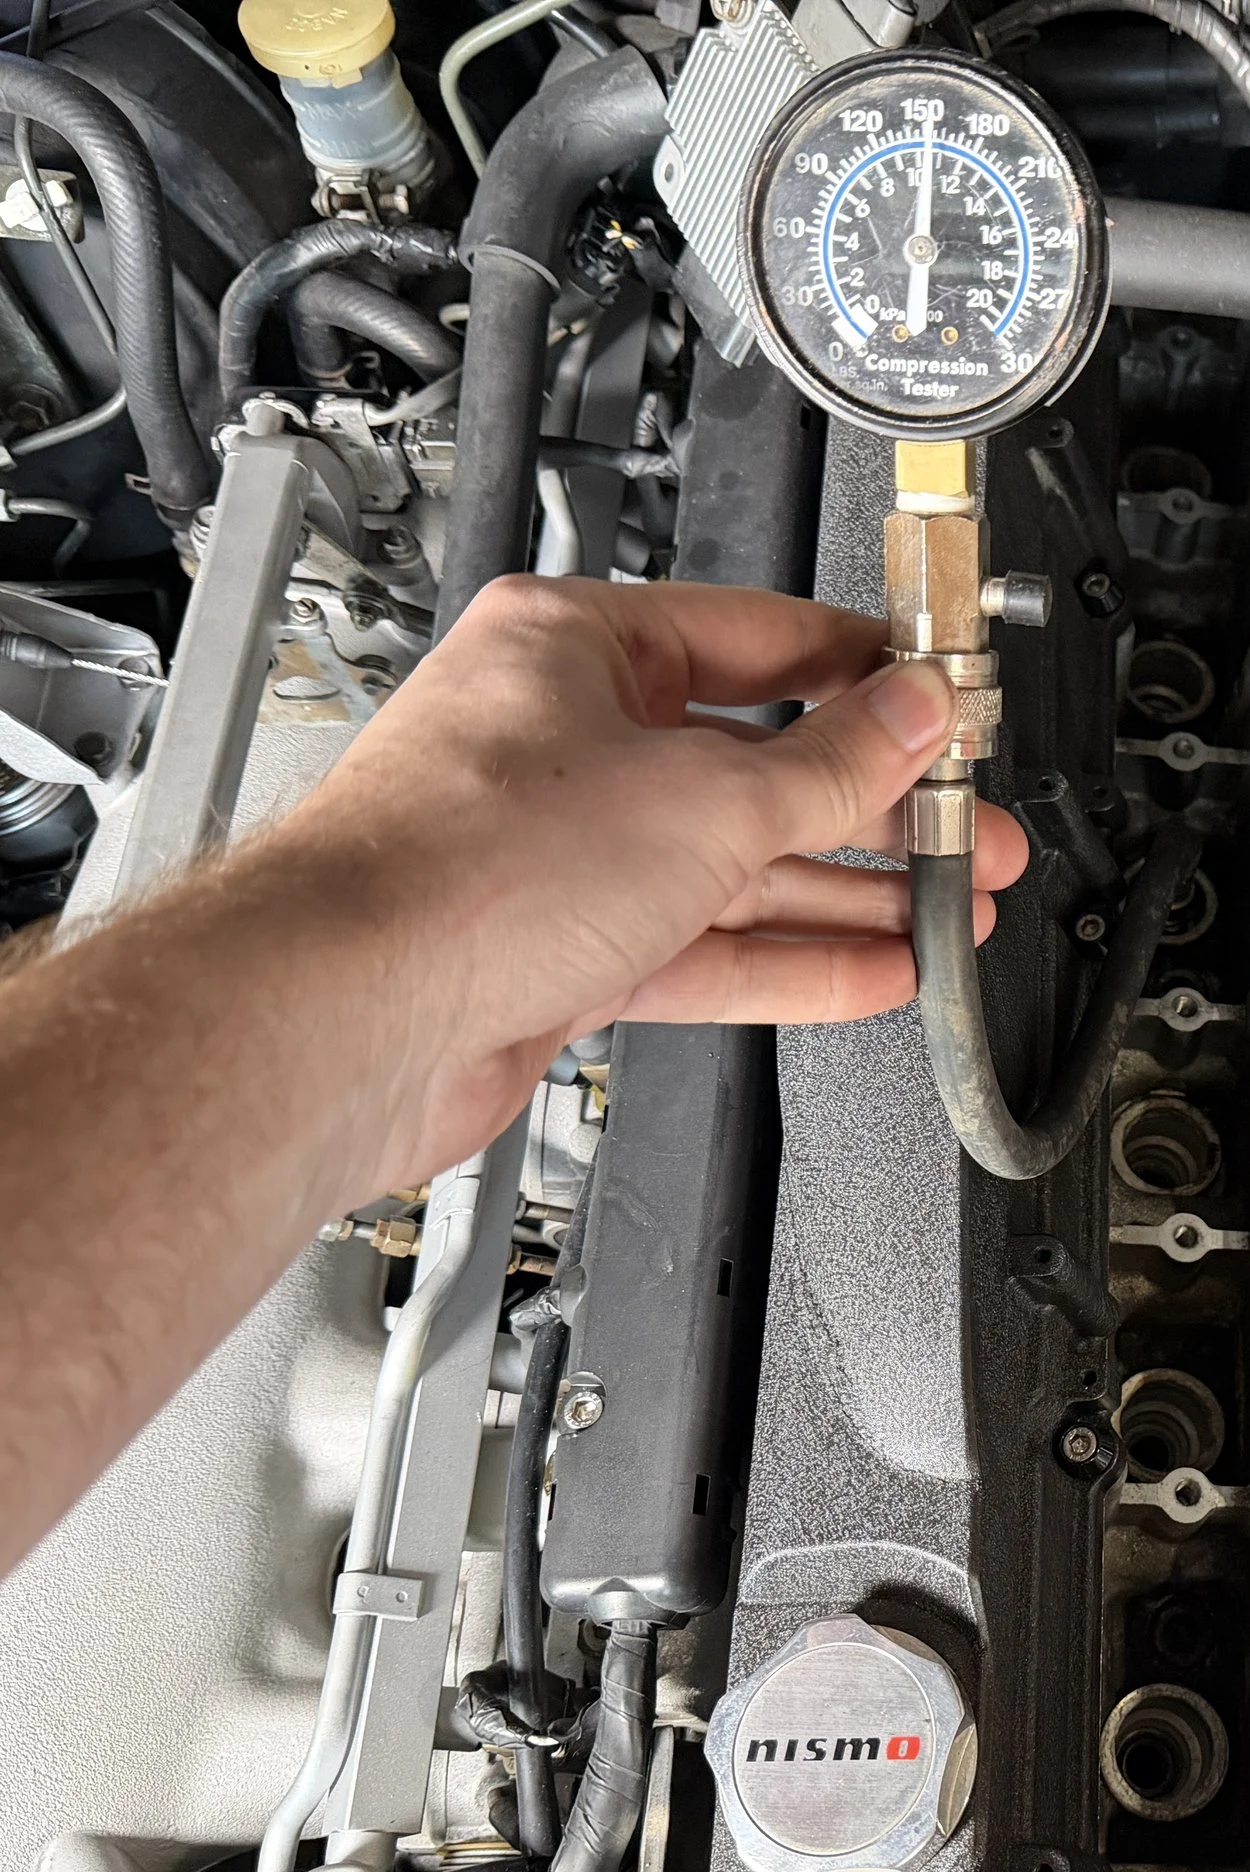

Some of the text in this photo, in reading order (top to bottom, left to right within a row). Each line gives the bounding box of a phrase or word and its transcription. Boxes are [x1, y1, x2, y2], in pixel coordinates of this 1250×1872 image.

[901, 98, 945, 121] 150
[839, 109, 883, 132] 120
[965, 113, 1010, 136] 180
[795, 152, 829, 175] 90
[1017, 156, 1062, 179] 210
[880, 178, 895, 197] 8
[939, 174, 961, 194] 12
[855, 199, 871, 218] 6
[963, 196, 986, 216] 14
[773, 217, 806, 239] 60
[980, 225, 1002, 244] 16
[1044, 227, 1079, 248] 24
[844, 232, 860, 251] 4
[850, 267, 865, 286] 2
[981, 260, 1003, 280] 18
[781, 285, 814, 306] 30
[864, 294, 880, 314] 0
[966, 288, 993, 308] 20
[1039, 288, 1071, 309] 27
[927, 310, 944, 322] 00
[828, 341, 843, 361] 0
[864, 353, 989, 377] Compression
[901, 378, 959, 399] Tester
[746, 1735, 921, 1762] nismo
